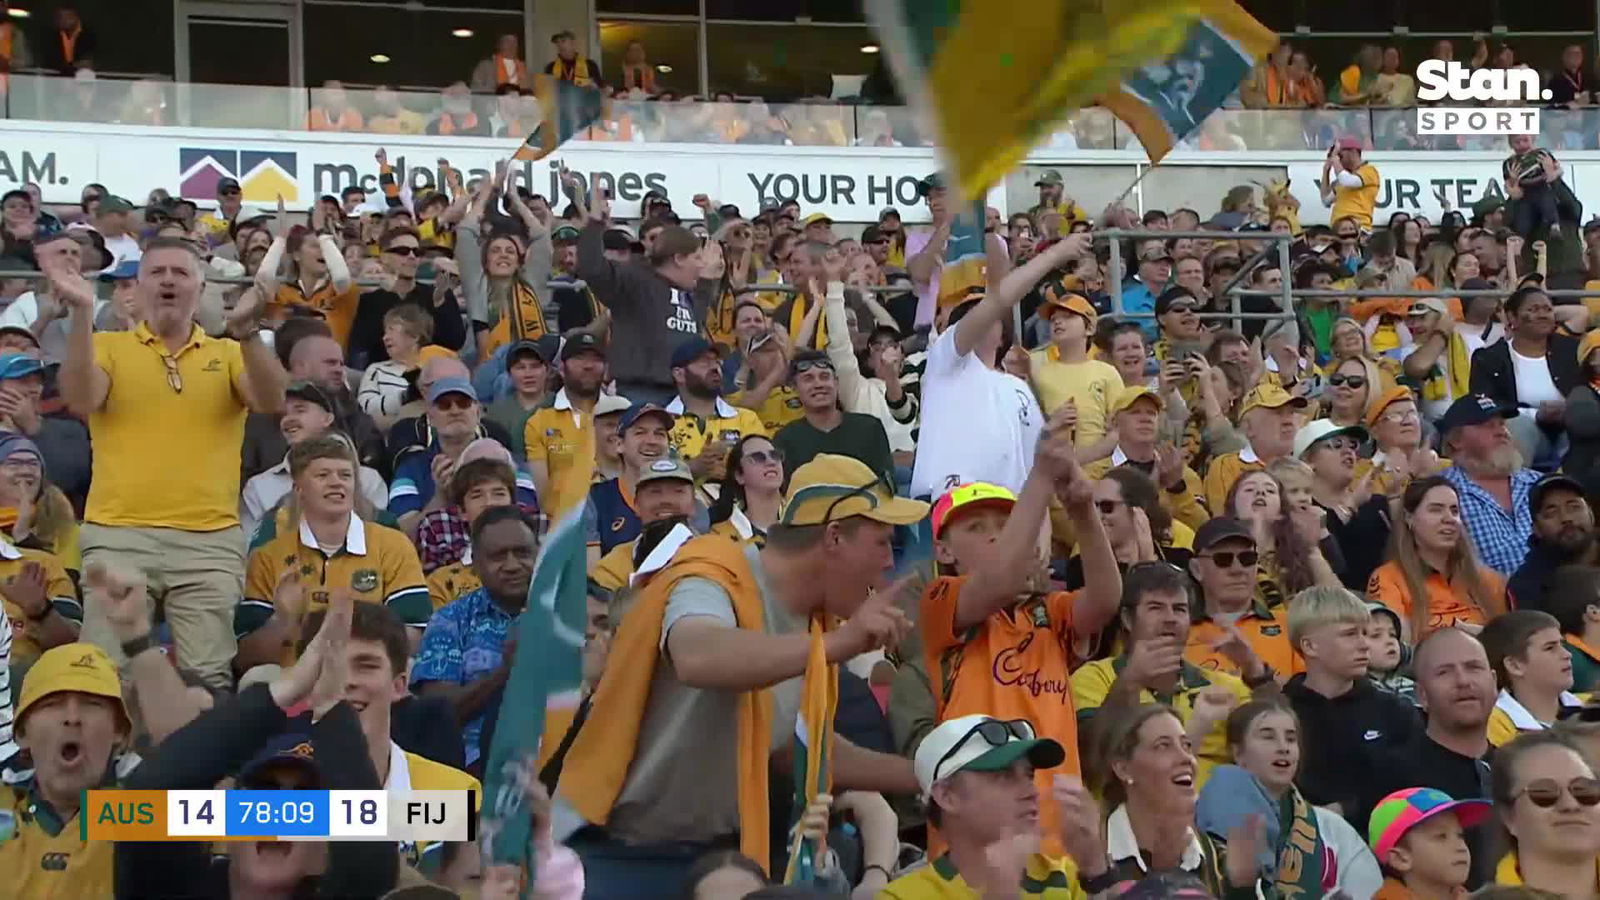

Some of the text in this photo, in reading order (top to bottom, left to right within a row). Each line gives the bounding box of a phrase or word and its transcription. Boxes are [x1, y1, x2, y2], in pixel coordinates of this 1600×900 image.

[747, 172, 930, 206] YOUR HO
[1313, 177, 1508, 209] UR TEA
[666, 316, 698, 334] GUTS
